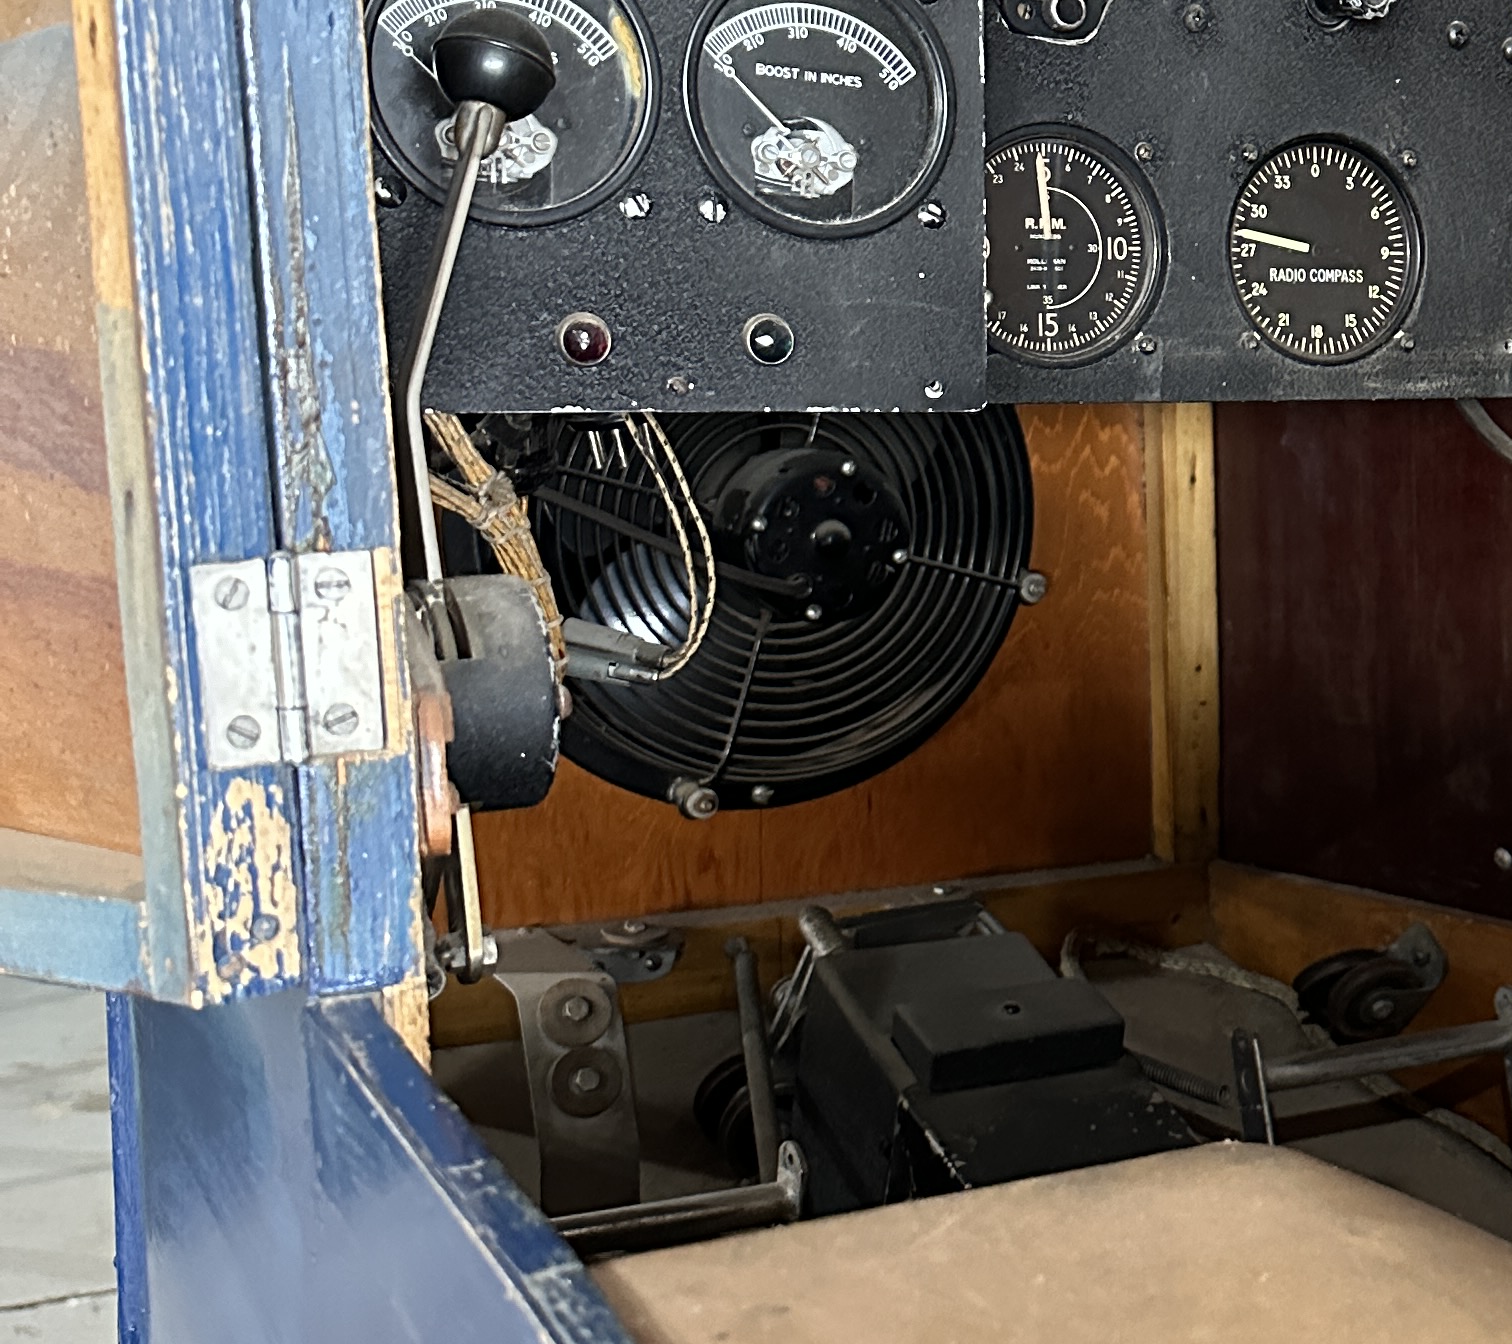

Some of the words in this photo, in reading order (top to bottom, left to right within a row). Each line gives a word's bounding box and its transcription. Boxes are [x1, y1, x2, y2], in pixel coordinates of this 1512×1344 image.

[755, 62, 800, 80] BOOST
[804, 70, 817, 83] IN
[820, 72, 863, 89] INCHES
[1014, 162, 1025, 172] 24
[1065, 163, 1071, 172] 6
[1310, 164, 1320, 178] 0
[992, 174, 1004, 184] 23
[1087, 175, 1093, 185] 7
[1274, 175, 1291, 190] 33
[1345, 176, 1355, 191] 3
[1105, 193, 1111, 204] 8
[1250, 204, 1268, 219] 30
[1370, 206, 1380, 220] 6
[1116, 217, 1123, 227] 9
[1087, 243, 1097, 253] 30
[1107, 236, 1128, 260] 10
[1240, 243, 1256, 258] 27
[1380, 246, 1390, 260] 9
[1116, 270, 1125, 279] 11
[1269, 267, 1306, 283] RADIO
[1309, 268, 1364, 283] COMPASS
[1251, 282, 1268, 296] 24
[1368, 285, 1380, 299] 12
[1042, 295, 1053, 305] 35
[1105, 292, 1114, 302] 12
[998, 310, 1007, 320] 17
[1088, 311, 1098, 321] 13
[1278, 313, 1290, 327] 21
[1345, 314, 1357, 328] 15
[1019, 323, 1029, 333] 16
[1038, 312, 1059, 337] 15
[1068, 323, 1076, 333] 14
[1311, 324, 1324, 339] 18
